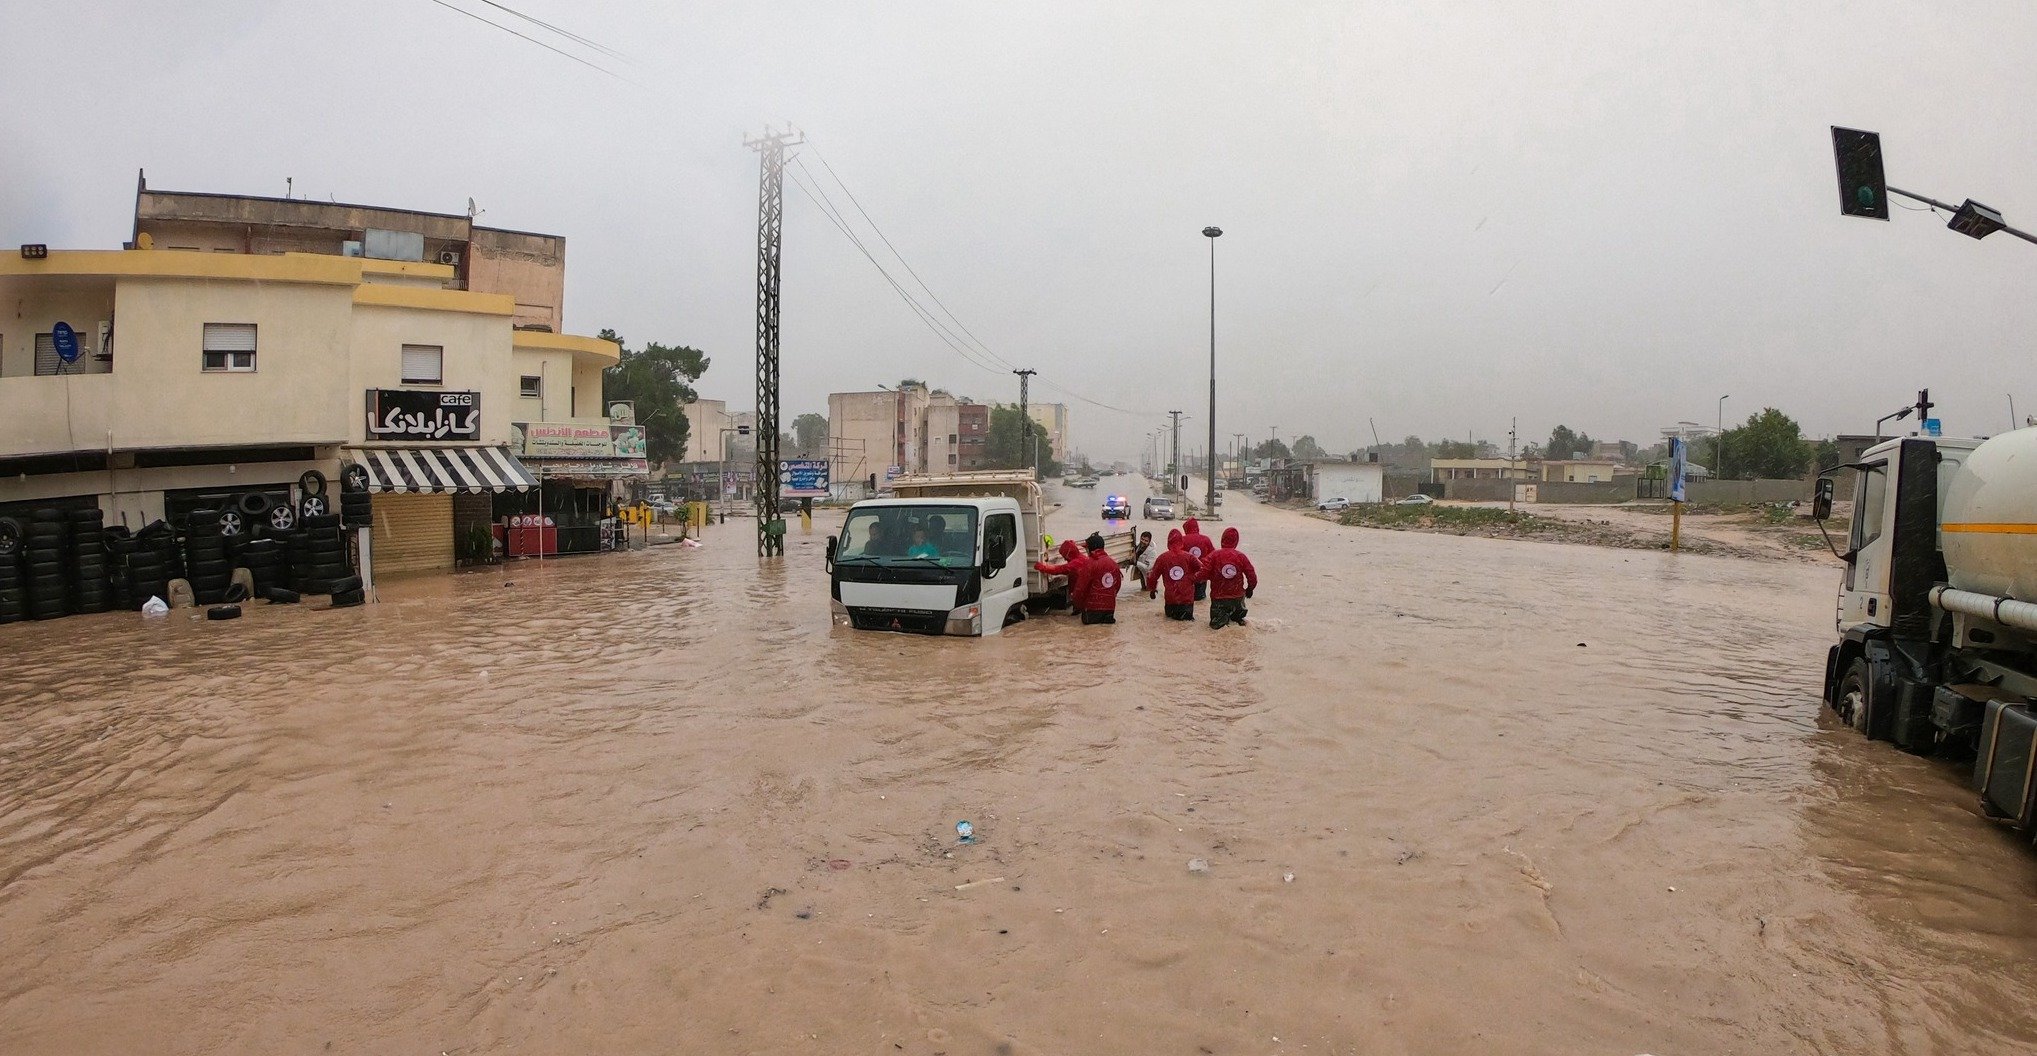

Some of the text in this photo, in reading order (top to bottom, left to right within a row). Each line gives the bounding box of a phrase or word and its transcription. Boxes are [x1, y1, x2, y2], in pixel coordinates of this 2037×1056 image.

[441, 395, 471, 405] cafe
[367, 407, 480, 439] كازابلانكا
[574, 428, 608, 438] مطعم
